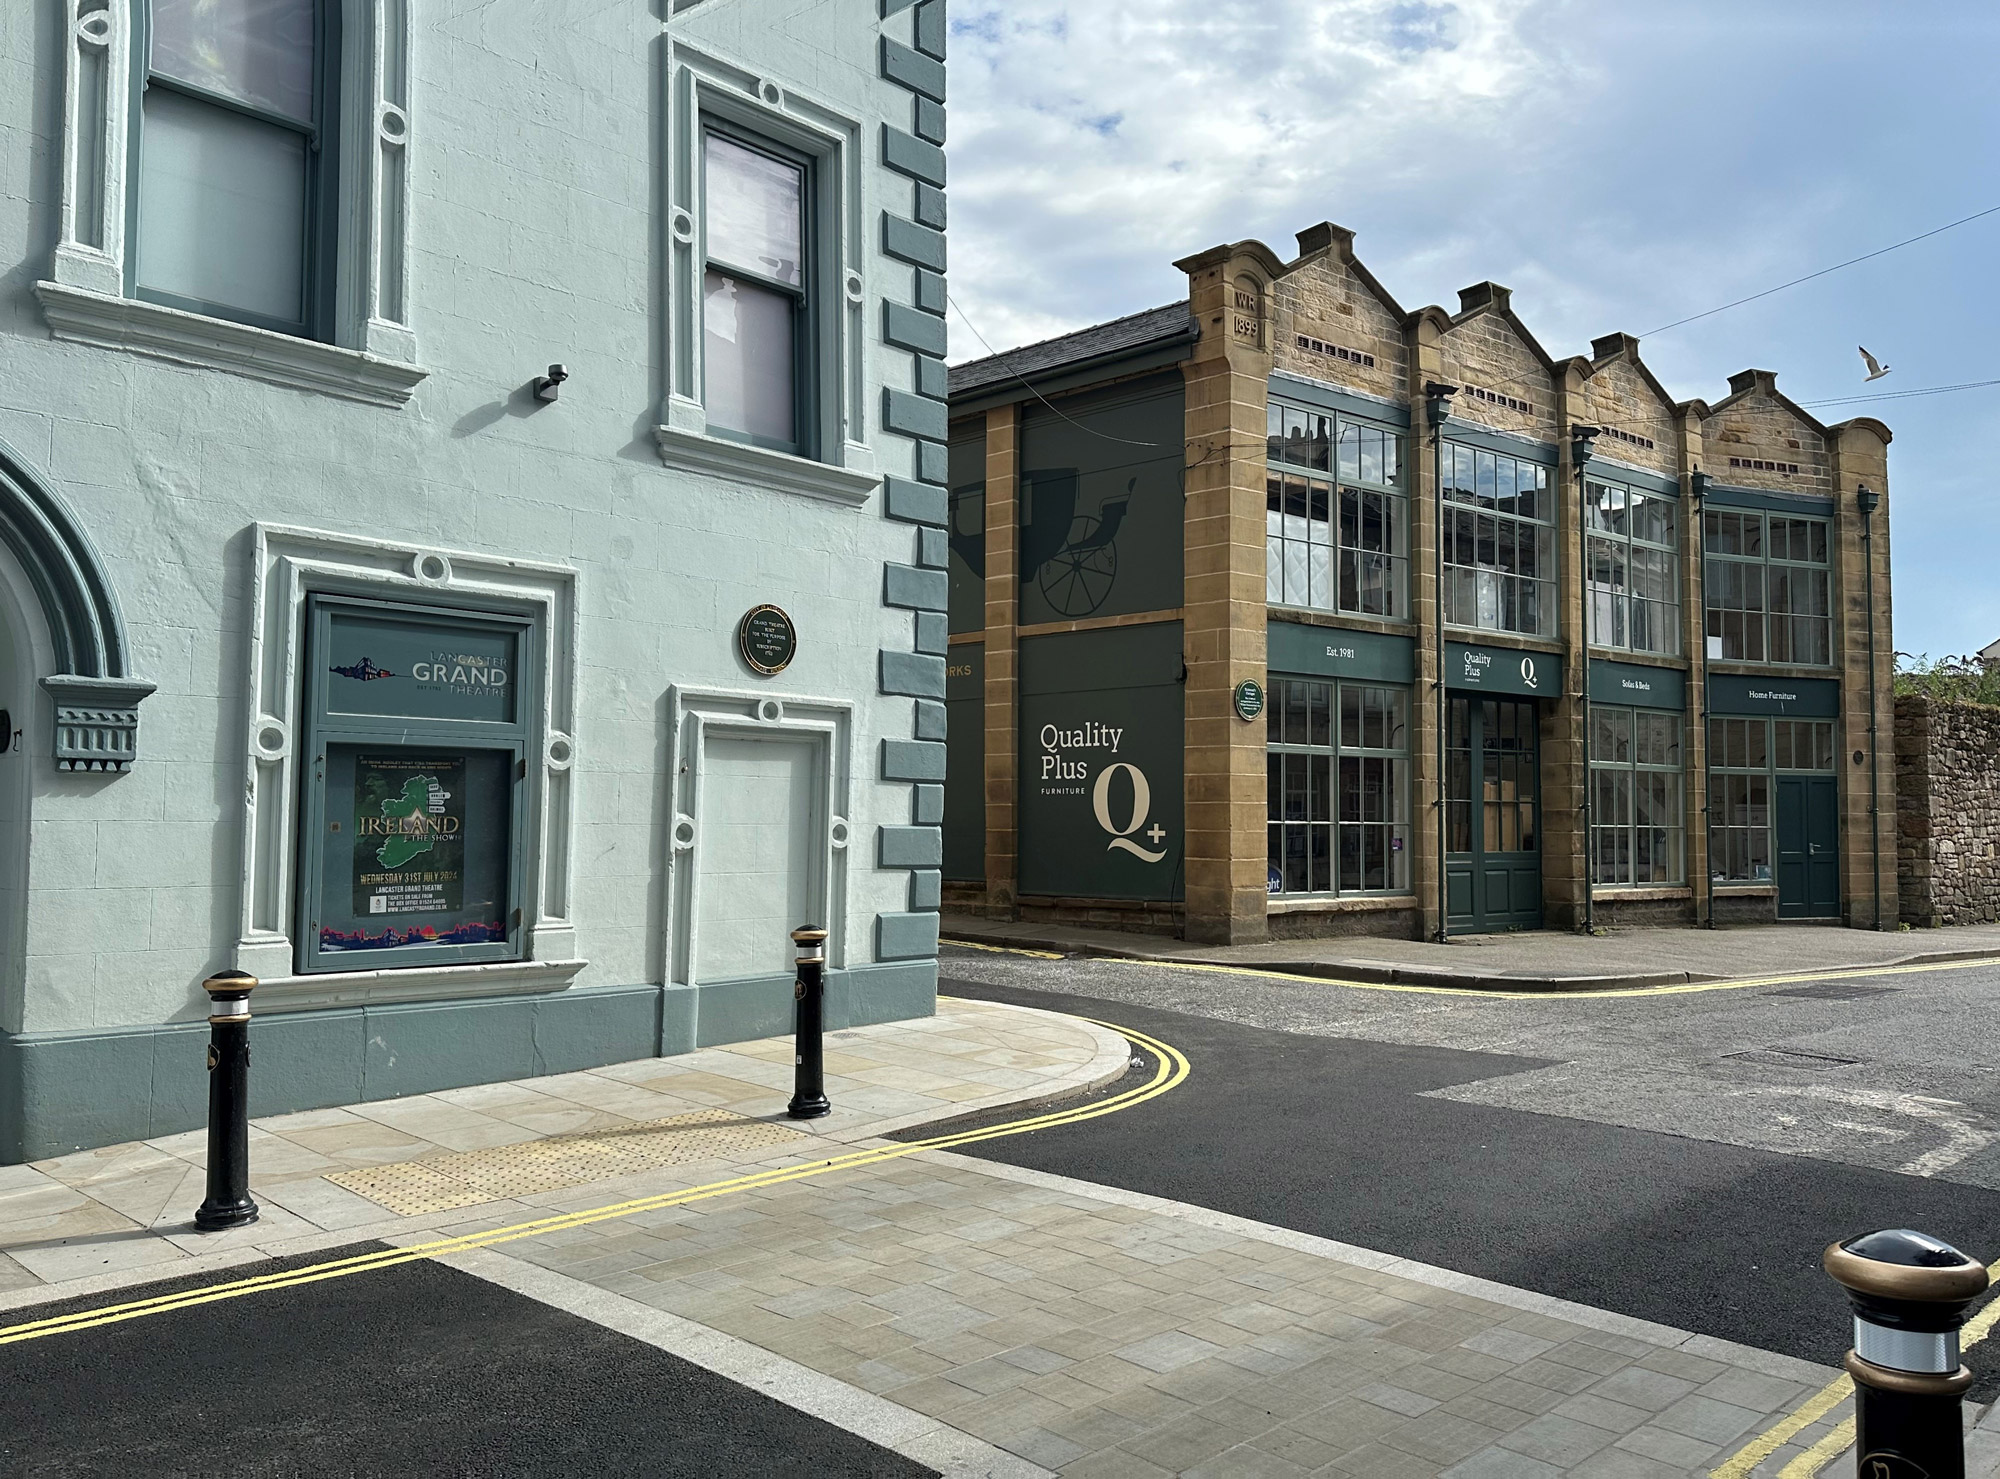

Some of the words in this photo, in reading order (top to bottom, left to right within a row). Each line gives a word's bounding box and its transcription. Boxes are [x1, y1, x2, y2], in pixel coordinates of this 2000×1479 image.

[1234, 316, 1258, 337] 1899
[430, 651, 508, 667] LANCASTER
[1326, 646, 1339, 657] Est.
[1339, 647, 1355, 659] 1981
[1464, 651, 1492, 668] Quality
[412, 662, 508, 686] GRAND
[1464, 664, 1481, 677] Plus
[449, 684, 507, 698] THEATRE
[1622, 679, 1635, 689] Sofas
[1639, 681, 1651, 691] Beds
[1749, 690, 1768, 699] Home
[1768, 691, 1797, 700] Furniture
[1040, 721, 1123, 753] Quality
[1041, 755, 1088, 780] Plus
[1041, 787, 1085, 795] FURNITURE
[359, 816, 460, 836] IRELAND
[410, 834, 429, 842] THE
[360, 873, 403, 885] WEDNESDAY
[404, 872, 421, 884] 31ST
[423, 871, 439, 883] JULY
[440, 871, 458, 881] 2024
[375, 885, 404, 894] LANCASTER
[404, 884, 421, 893] GRAND
[422, 884, 443, 892] THEATRE
